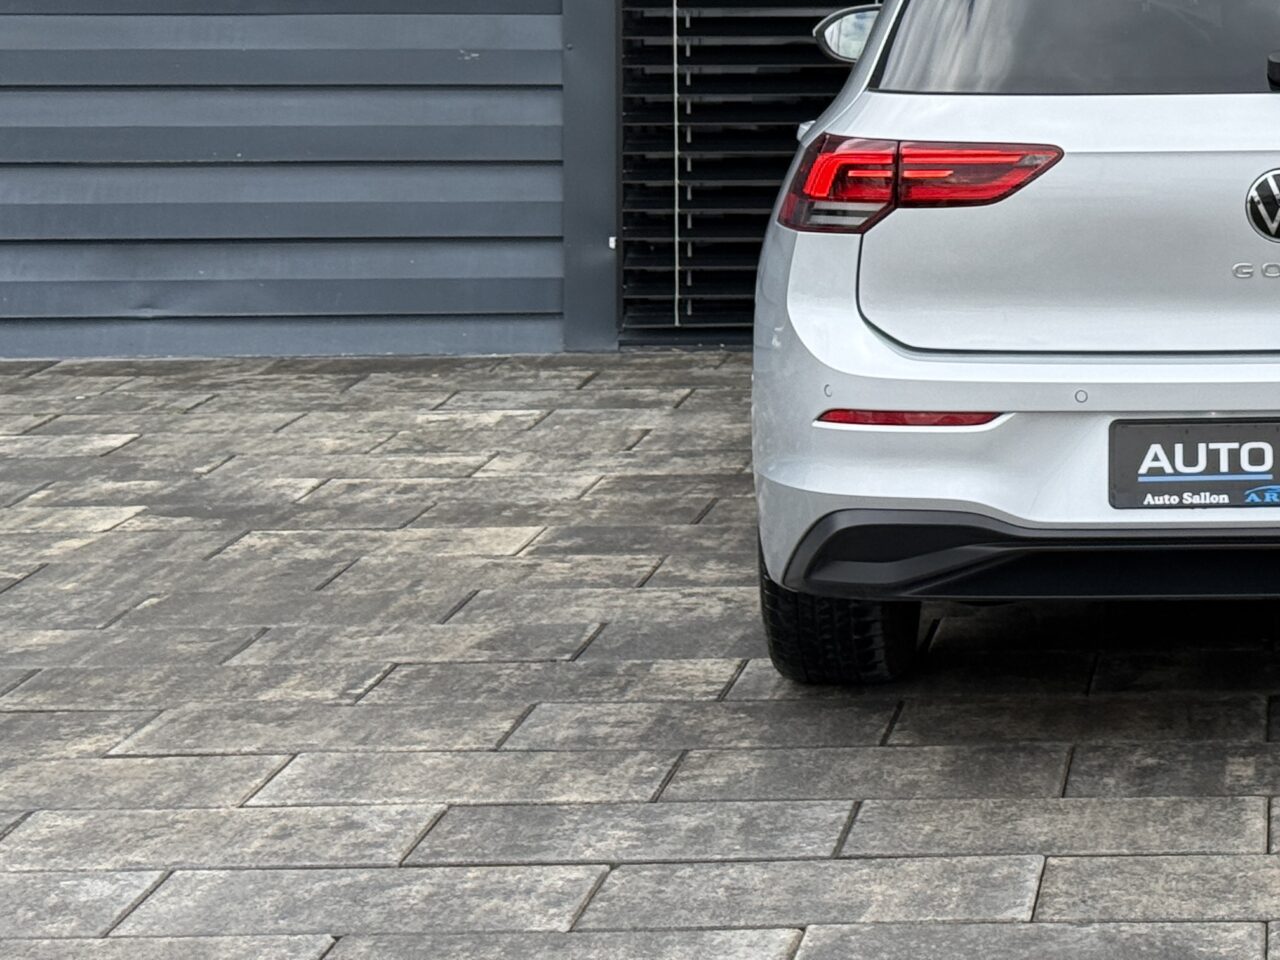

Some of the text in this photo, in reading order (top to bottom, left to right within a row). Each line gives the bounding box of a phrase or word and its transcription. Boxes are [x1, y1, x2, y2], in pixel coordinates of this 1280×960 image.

[1138, 441, 1274, 475] AUTO
[1143, 492, 1180, 505] Auto
[1182, 491, 1230, 504] Sallon
